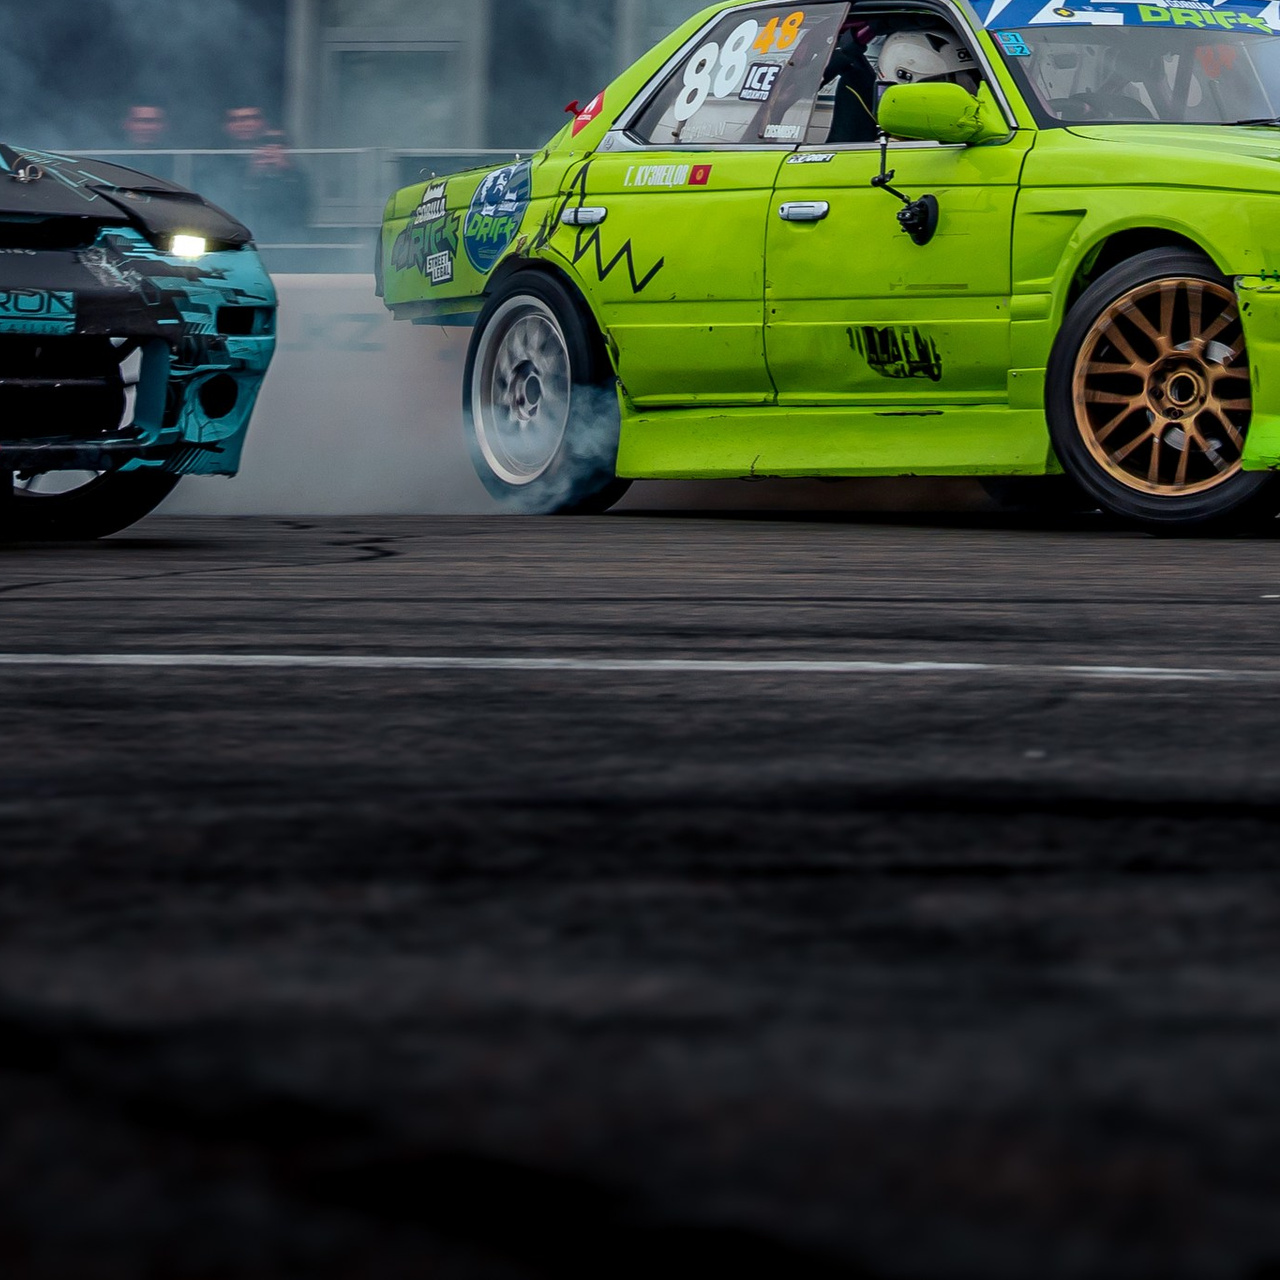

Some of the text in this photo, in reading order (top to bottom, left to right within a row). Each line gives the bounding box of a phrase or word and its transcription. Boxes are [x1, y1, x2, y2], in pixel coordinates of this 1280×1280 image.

[1165, 0, 1215, 11] GORILLA
[1137, 4, 1273, 35] DRIFT
[752, 11, 805, 55] 48
[674, 19, 758, 121] 88
[744, 66, 780, 90] ICE
[623, 164, 690, 188] Г. КУЗНЕЦОВ
[465, 215, 517, 244] DRIFT
[427, 253, 449, 270] STREET
[433, 264, 451, 280] LEGAL
